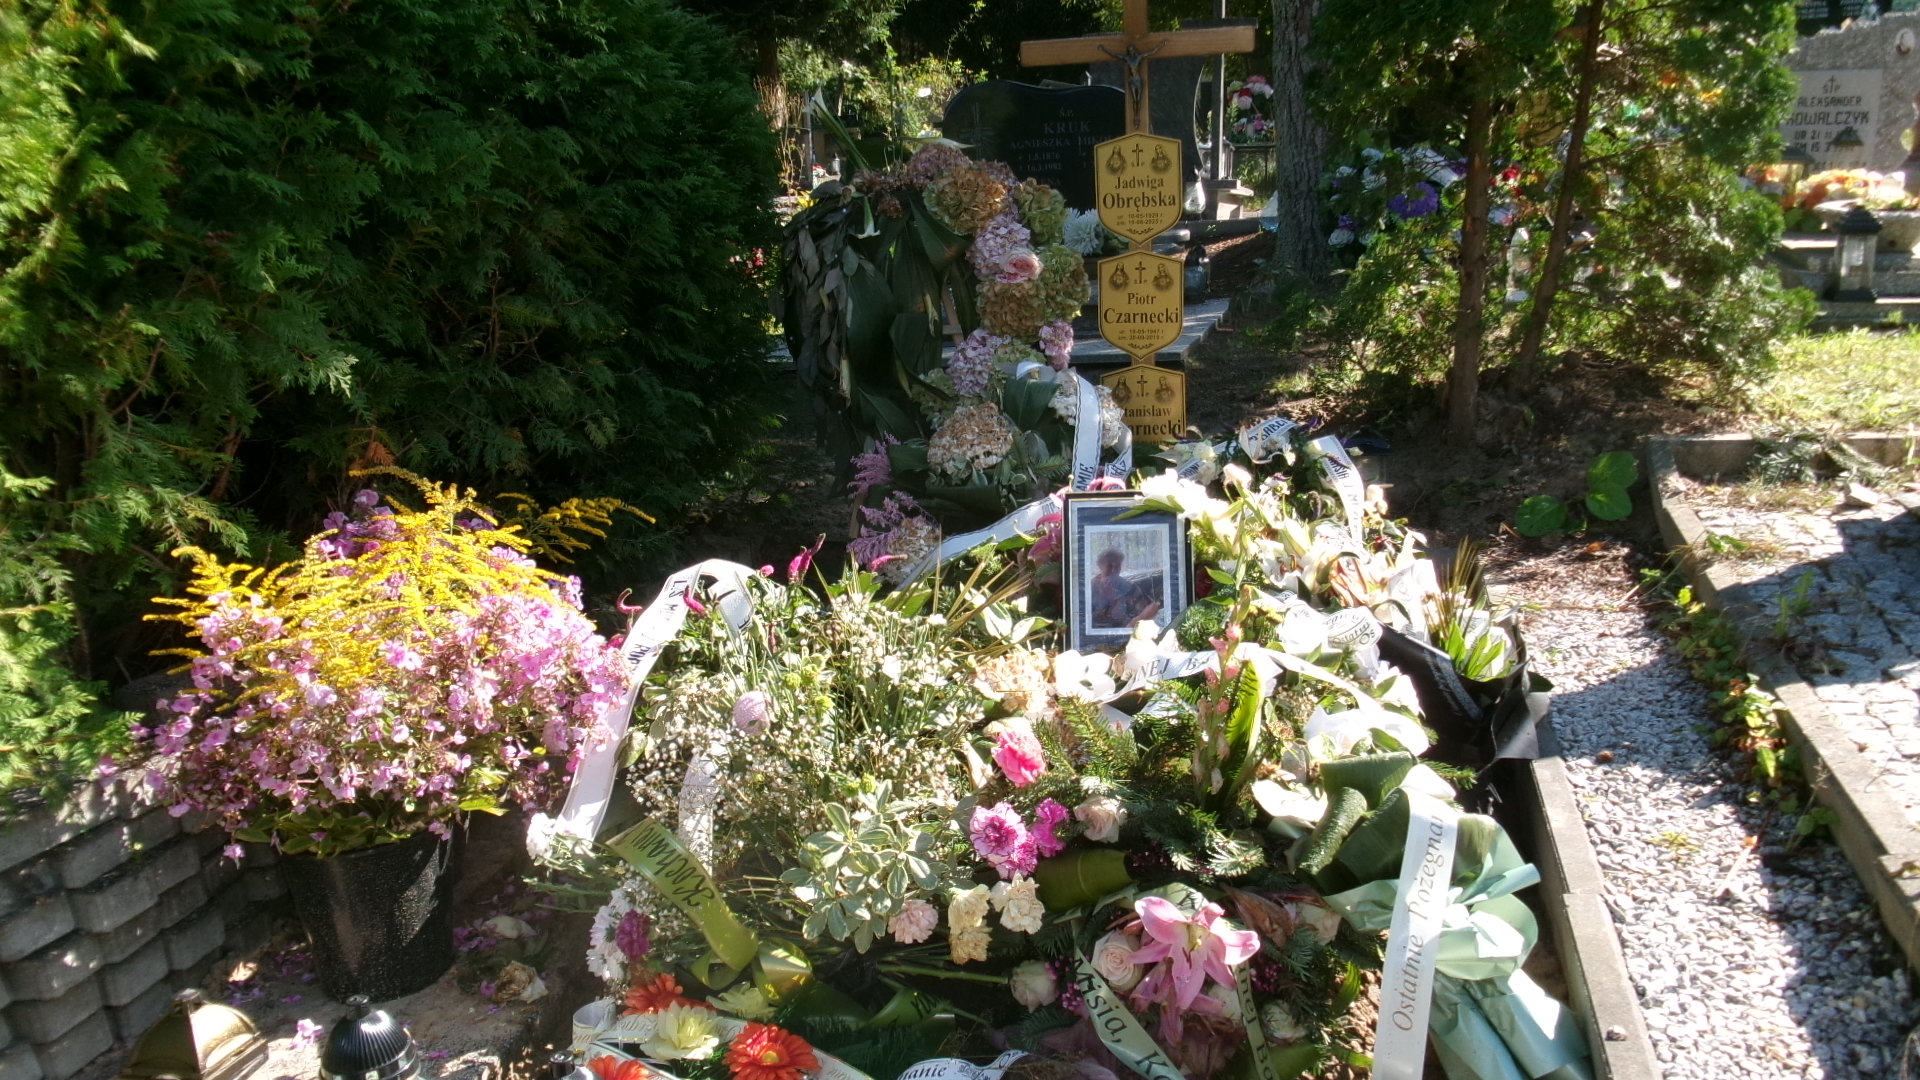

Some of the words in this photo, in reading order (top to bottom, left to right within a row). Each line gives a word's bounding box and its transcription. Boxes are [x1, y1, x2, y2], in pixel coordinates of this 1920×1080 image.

[1796, 95, 1863, 108] ALEKSANDER
[1043, 120, 1091, 135] KRUK
[1009, 136, 1071, 151] AGNIESZKA
[1113, 174, 1165, 192] Jadwiga
[1102, 190, 1176, 212] Obrębska
[1127, 292, 1157, 305] Piotr
[1103, 306, 1180, 324] Czarnecki
[1123, 404, 1172, 418] tanisław
[1127, 419, 1182, 436] arnecki
[1392, 933, 1425, 1032] Ostatnie
